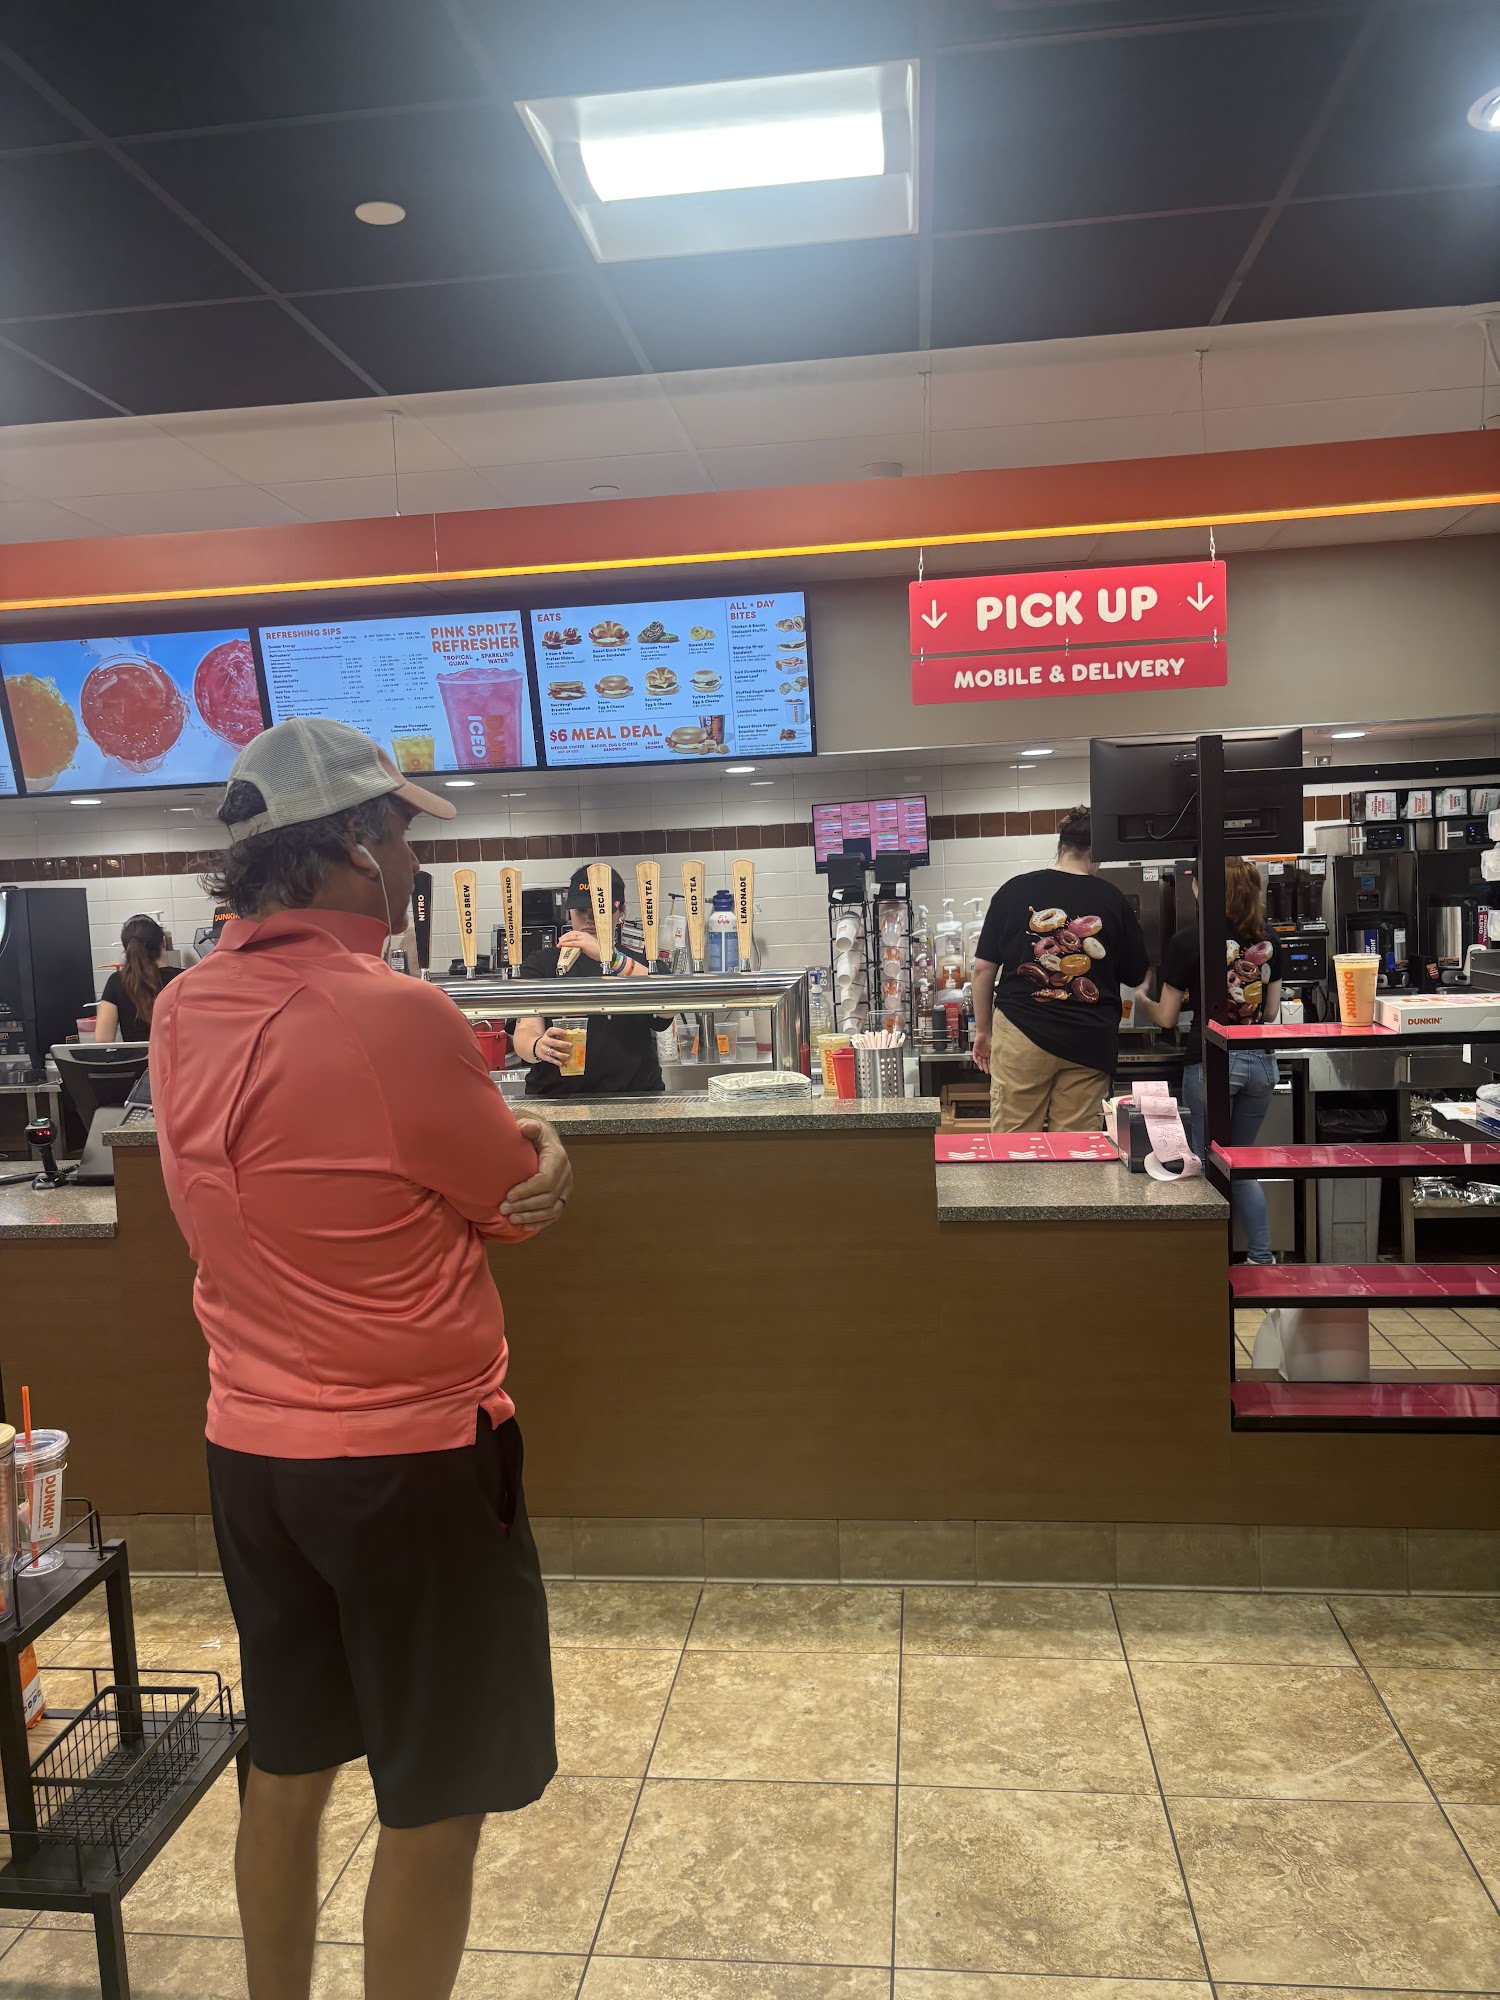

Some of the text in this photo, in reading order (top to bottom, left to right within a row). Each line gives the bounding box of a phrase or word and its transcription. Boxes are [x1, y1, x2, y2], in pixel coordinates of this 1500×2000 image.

[537, 613, 561, 622] EATS
[730, 600, 775, 610] ALL DAY
[730, 611, 756, 620] BITES
[977, 586, 1158, 632] PICK UP
[266, 629, 320, 640] REFRESHING
[322, 628, 341, 636] SIPS
[431, 626, 464, 639] PINK
[468, 622, 517, 637] SPRITZ
[432, 636, 519, 653] REFRESHER
[954, 657, 1185, 689] MOBILE & DELIVERY
[468, 715, 486, 758] ICED
[549, 724, 663, 743] $6 MEAL DEAL
[418, 894, 426, 921] NITRO
[463, 885, 473, 935] COLD BREW
[505, 876, 515, 945] ORIGINAL BLEND
[597, 887, 606, 914] DECAF
[739, 876, 747, 924] LEMONADE
[1344, 971, 1357, 1018] DUNKIN'
[1407, 1017, 1442, 1025] DUNKIN'
[825, 1049, 835, 1086] DUNKIN'
[43, 1474, 57, 1529] DUNKIN'
